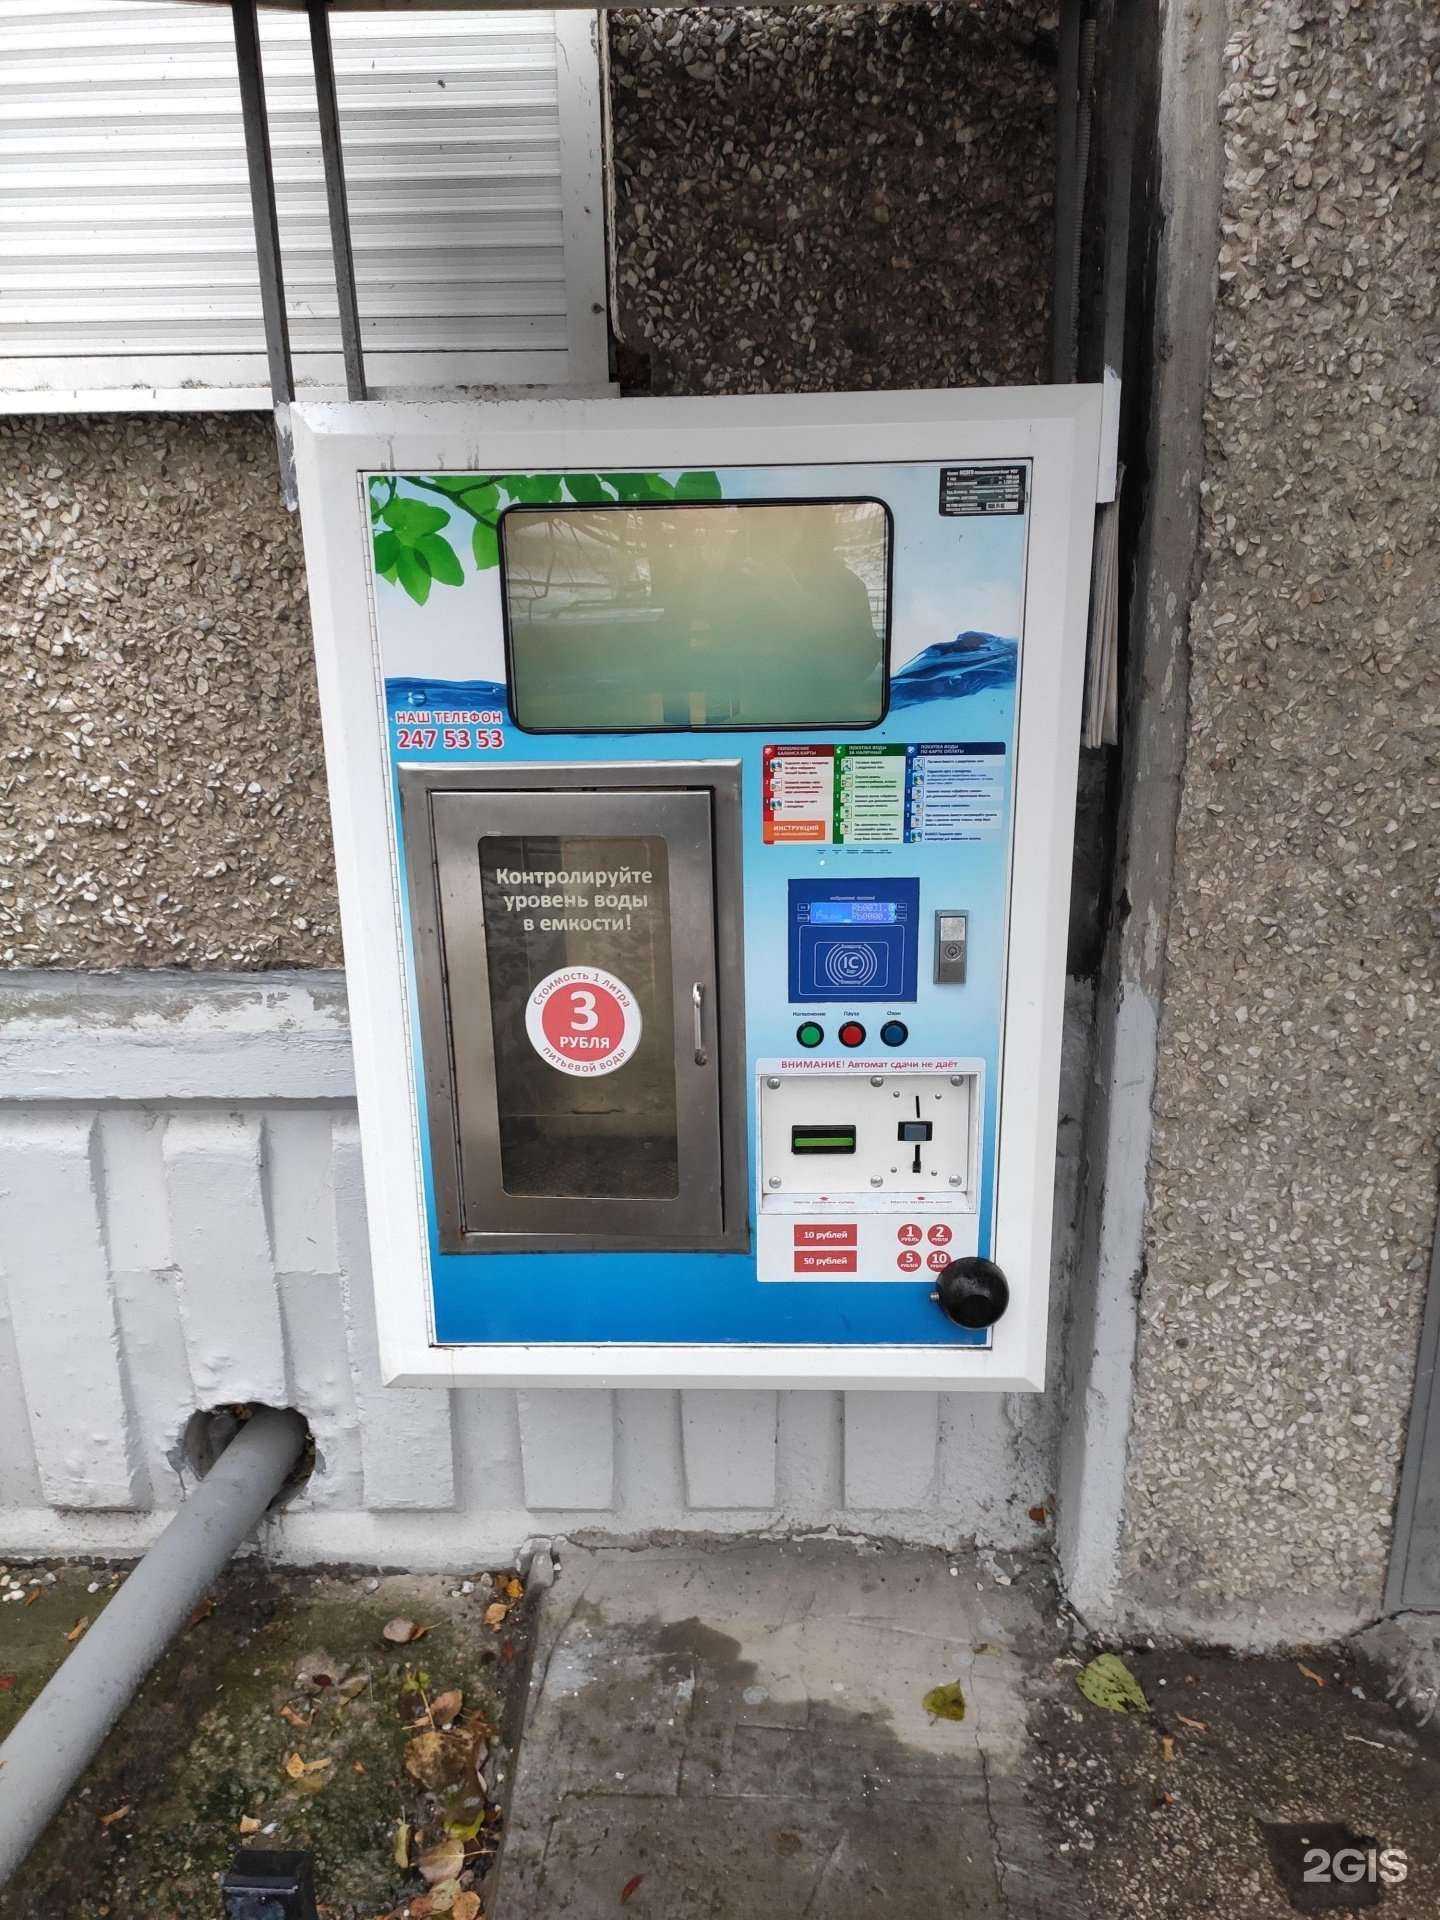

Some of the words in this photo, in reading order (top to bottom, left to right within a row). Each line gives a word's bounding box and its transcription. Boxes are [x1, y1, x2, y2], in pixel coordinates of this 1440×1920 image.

[396, 711, 430, 723] НАШ
[434, 711, 502, 723] ТЕЛЕФОН
[398, 729, 436, 748] 247
[444, 729, 470, 748] 53
[477, 729, 503, 748] 53
[496, 866, 653, 888] Контролируйте
[503, 894, 588, 912] уровень
[594, 894, 648, 911] воды
[523, 918, 535, 931] в
[540, 913, 632, 931] емкости!
[533, 972, 589, 1006] Стоимость
[591, 973, 600, 982] 1
[601, 979, 631, 1008] литра
[570, 990, 599, 1031] 3
[560, 1036, 610, 1049] РУБЛЯ
[542, 1046, 597, 1073] питьевой
[600, 1048, 627, 1070] воды
[781, 1060, 845, 1069] ВНИМАНИЕ!
[848, 1060, 888, 1069] Автомат
[890, 1061, 919, 1070] сдачи
[803, 1231, 815, 1239] 10
[816, 1230, 848, 1240] рублей
[906, 1226, 915, 1237] 1
[936, 1226, 945, 1238] 2
[803, 1257, 815, 1265] 50
[816, 1256, 848, 1266] рублей
[905, 1253, 914, 1263] 5
[932, 1253, 948, 1264] 10
